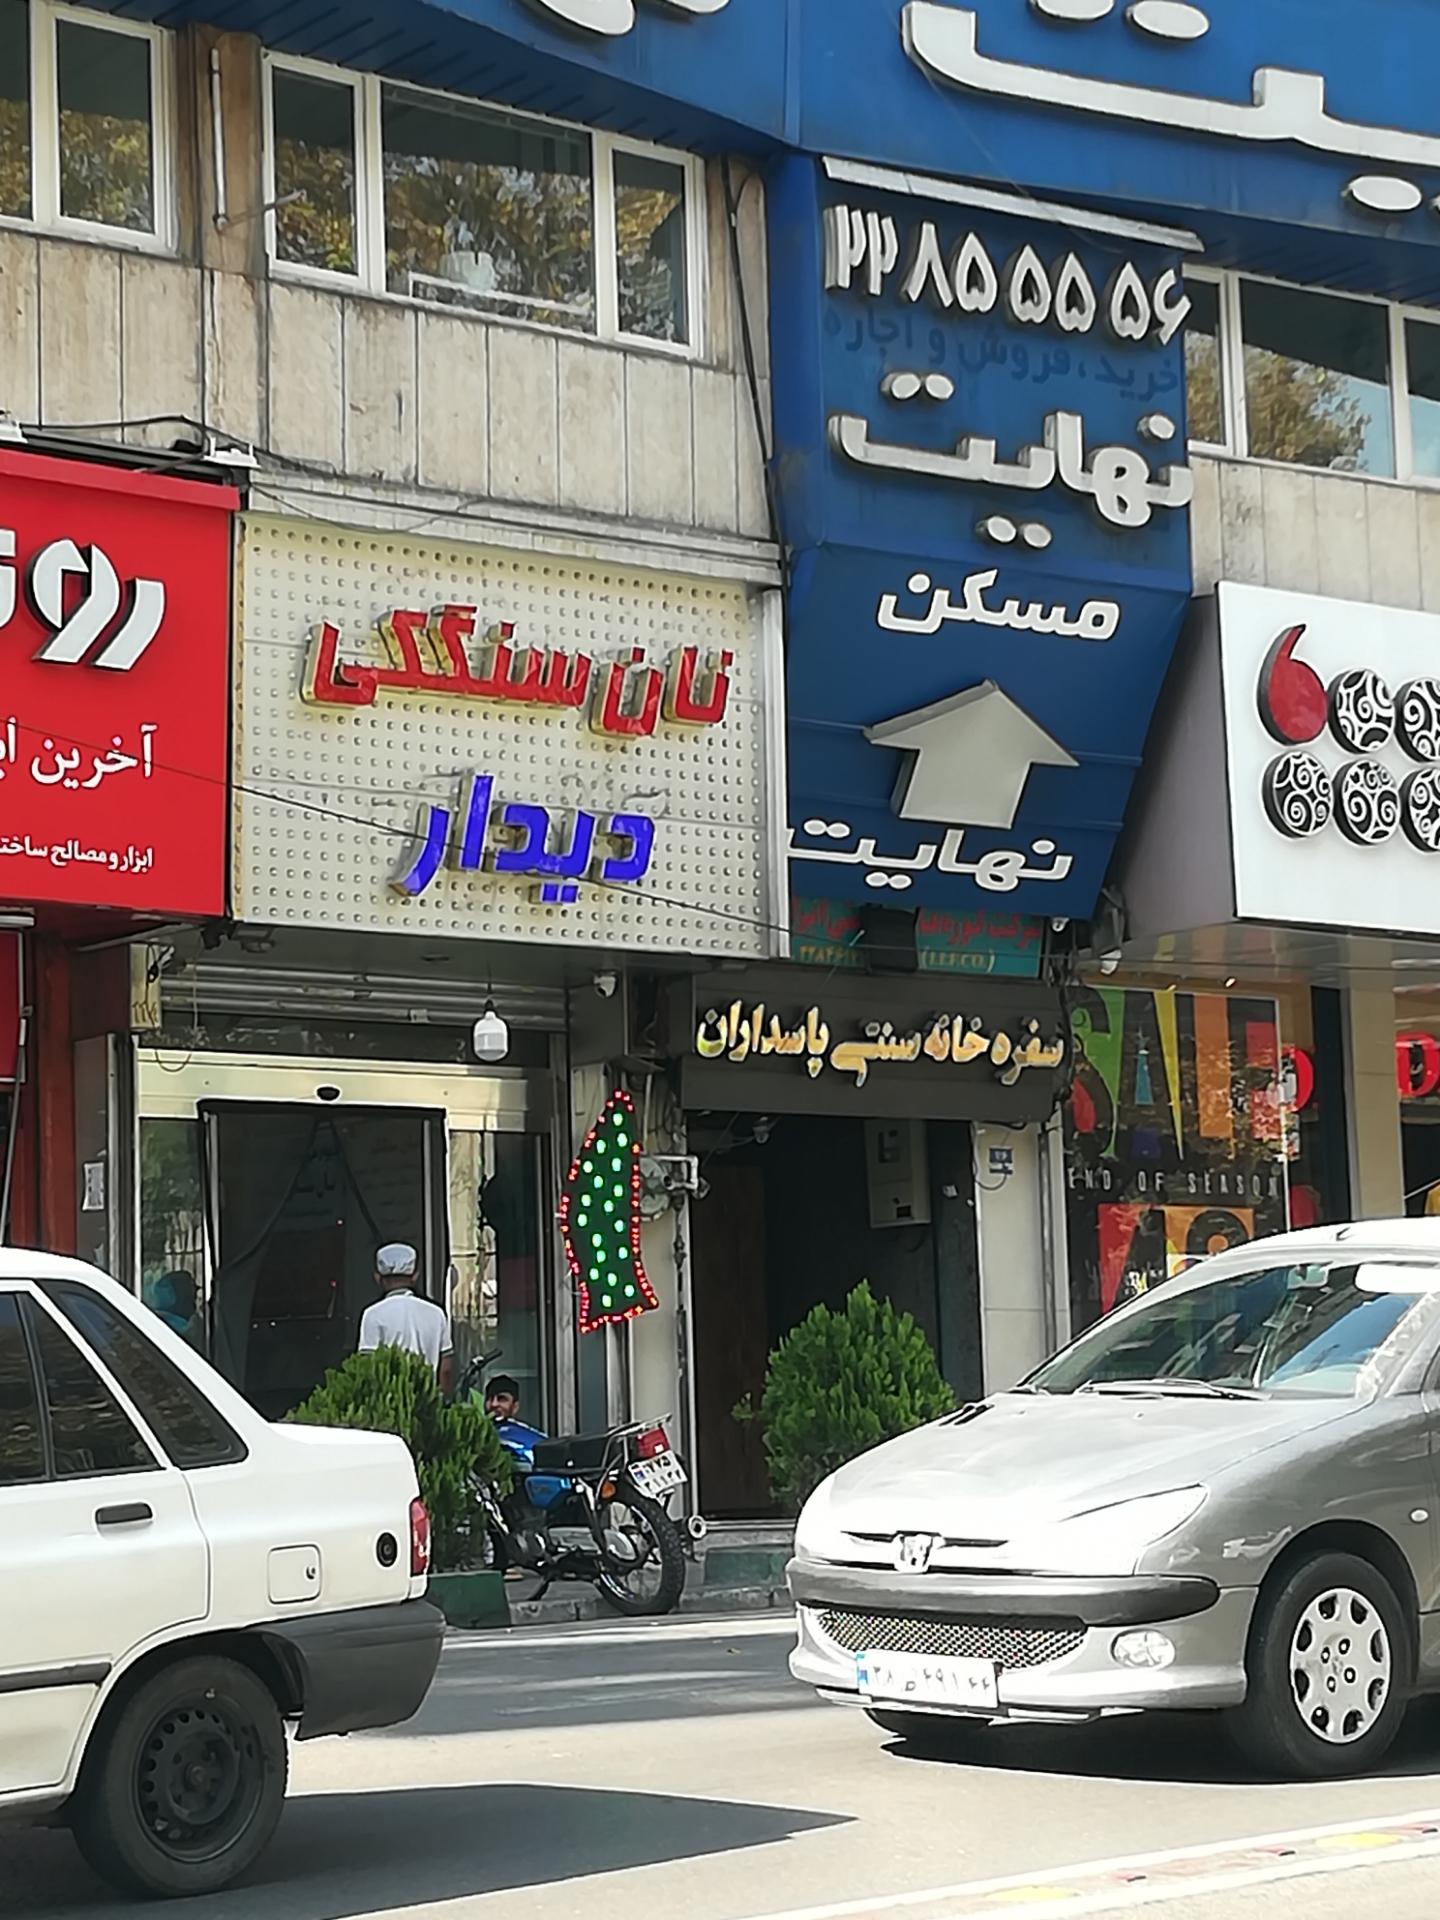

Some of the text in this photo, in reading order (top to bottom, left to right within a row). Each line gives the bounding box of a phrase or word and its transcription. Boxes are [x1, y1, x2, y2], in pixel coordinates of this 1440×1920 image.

[828, 371, 1193, 549] نهایت
[877, 568, 1120, 640] مسکن
[303, 604, 734, 738] نان سنگکی
[31, 723, 158, 789] آخرین
[50, 839, 108, 867] مصالح
[394, 775, 655, 904] دیدار
[786, 818, 1073, 892] نهایت
[696, 1000, 1065, 1088] سفره خانه سنتی پاسداران
[1066, 1166, 1279, 1197] END OF SEASON
